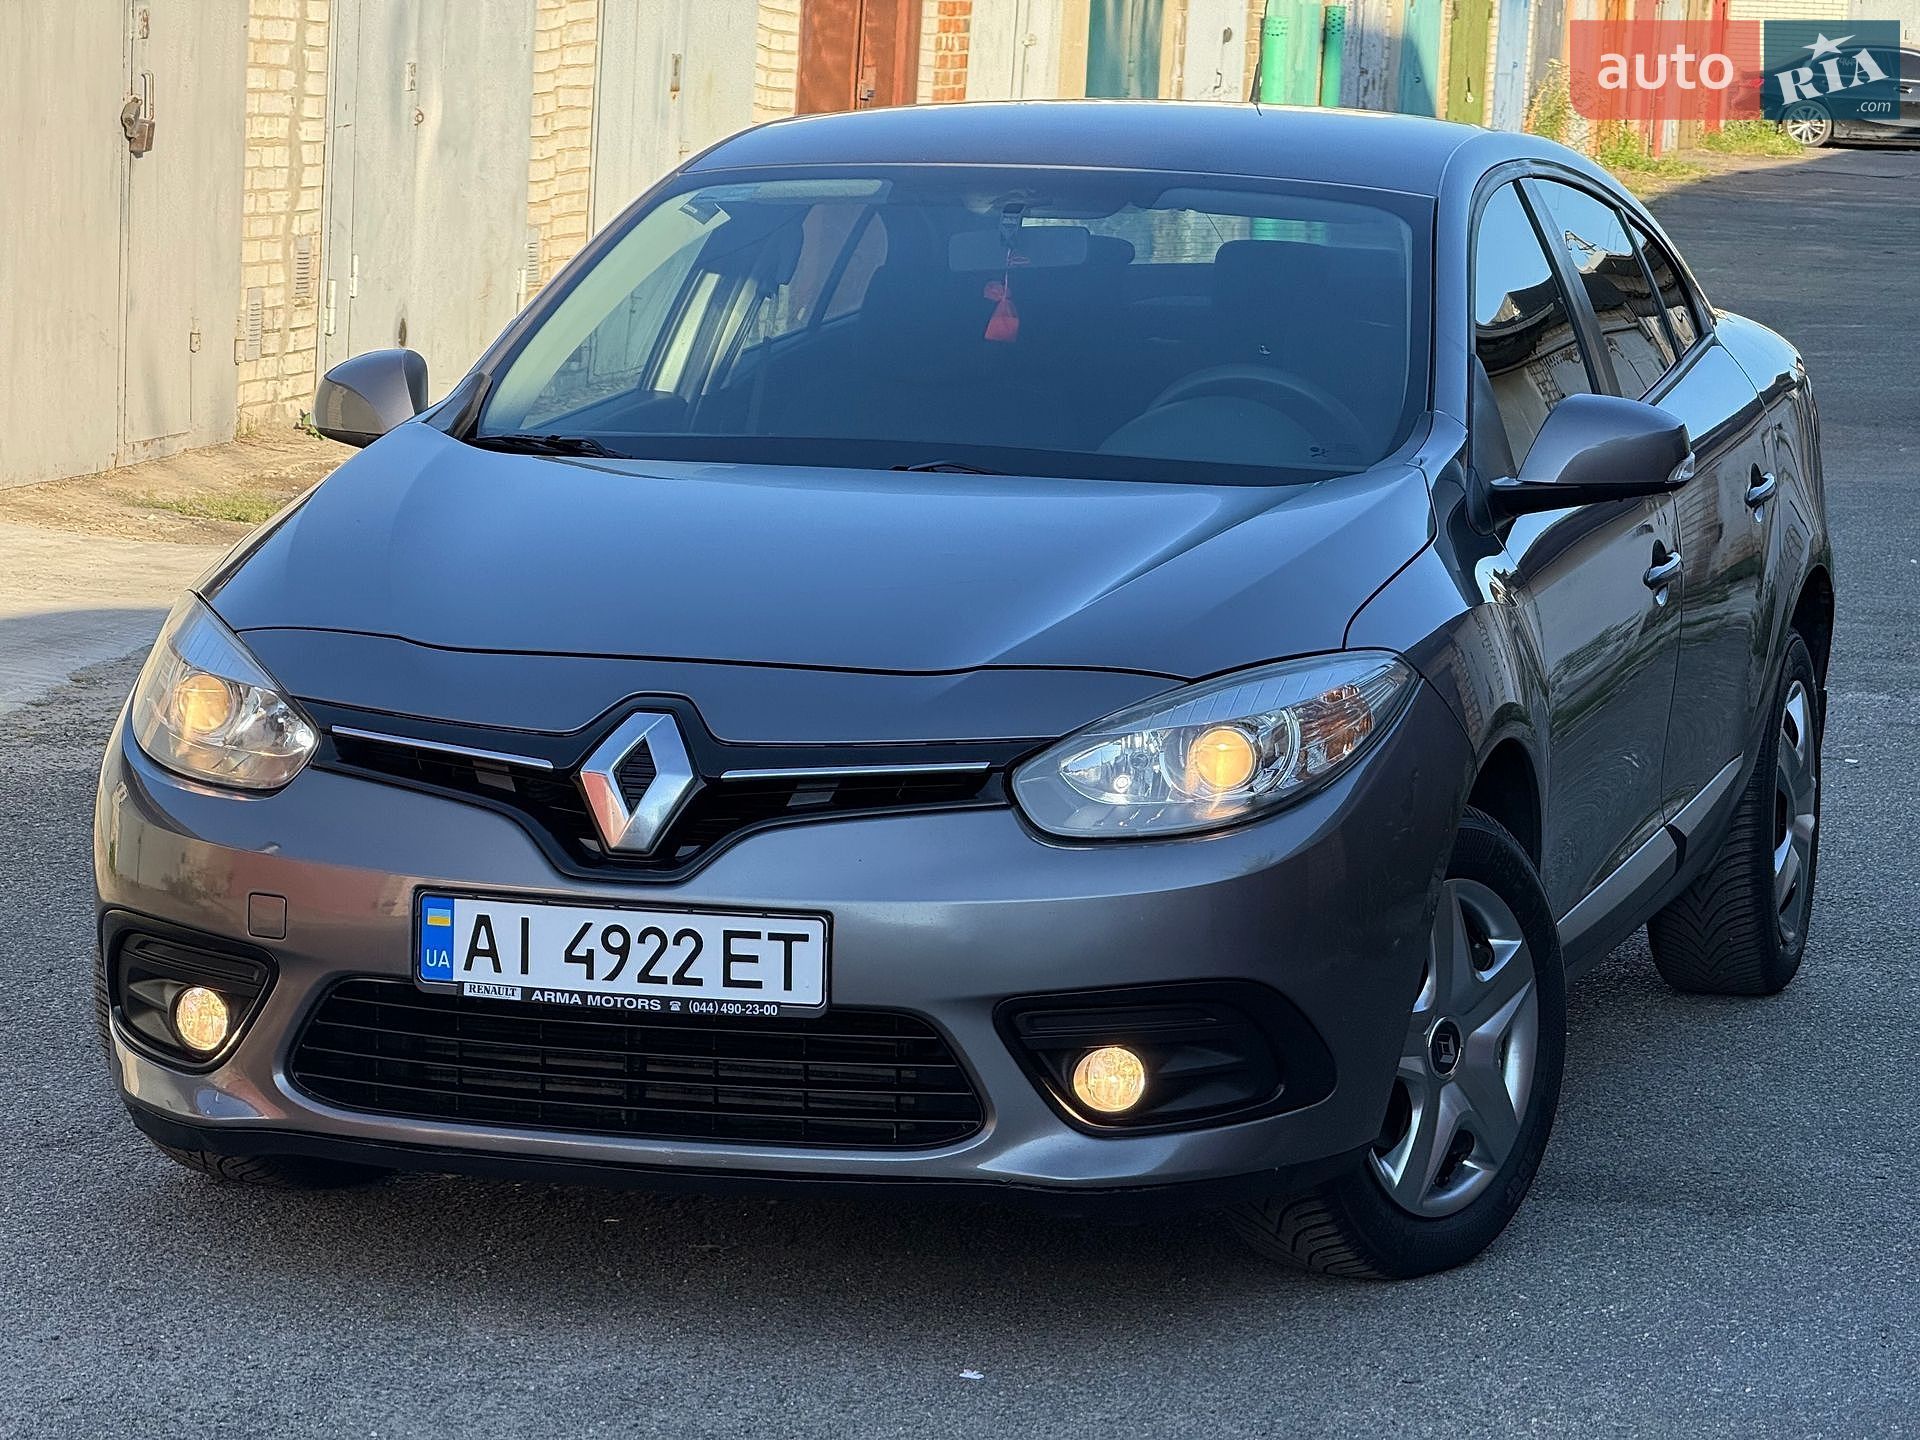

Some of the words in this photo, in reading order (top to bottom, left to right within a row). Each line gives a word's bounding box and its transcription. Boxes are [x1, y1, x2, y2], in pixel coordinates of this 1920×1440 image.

[426, 948, 450, 968] UA
[463, 914, 529, 975] AI
[564, 922, 703, 986] 4922
[722, 929, 810, 991] ET
[468, 984, 518, 998] RENAULT
[531, 990, 582, 1005] ARMA
[587, 994, 661, 1011] MOTORS
